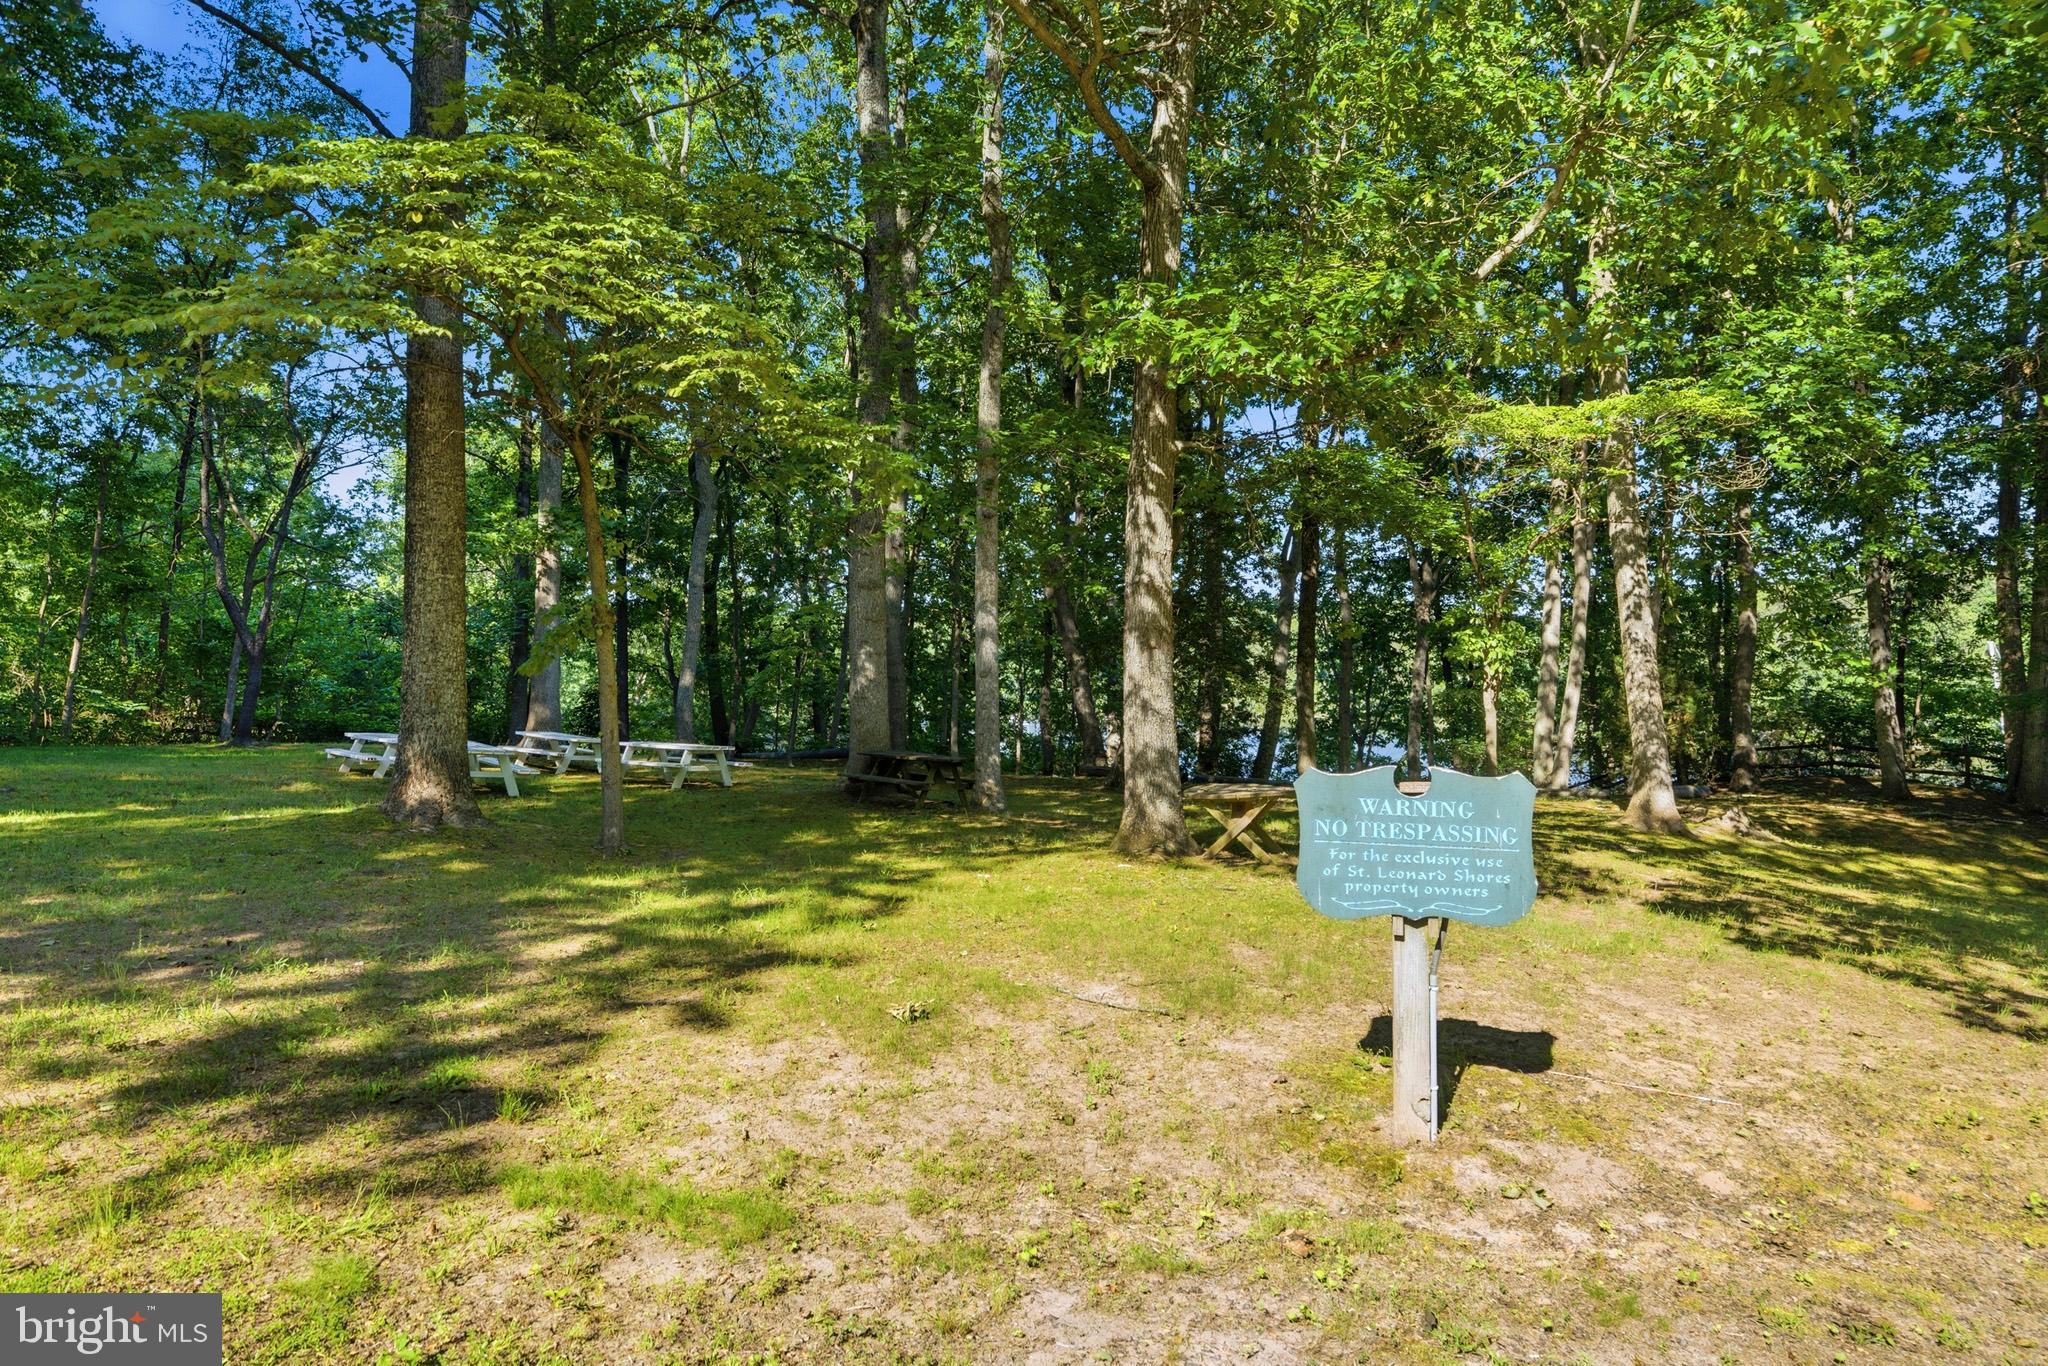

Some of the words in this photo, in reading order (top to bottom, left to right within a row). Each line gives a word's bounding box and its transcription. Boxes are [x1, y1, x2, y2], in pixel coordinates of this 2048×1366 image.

[1359, 797, 1474, 819] WARNING
[1314, 819, 1348, 838] NO
[1355, 820, 1520, 845] TRESPASSING
[1328, 848, 1356, 861] For
[1363, 848, 1389, 862] the
[1395, 852, 1469, 867] exclusive
[1476, 857, 1504, 868] use
[1322, 864, 1339, 878] of
[1348, 865, 1370, 878] St.
[1378, 866, 1446, 882] Leonard
[1454, 870, 1511, 885] Shores
[1344, 881, 1419, 898] property
[1424, 886, 1489, 898] owners
